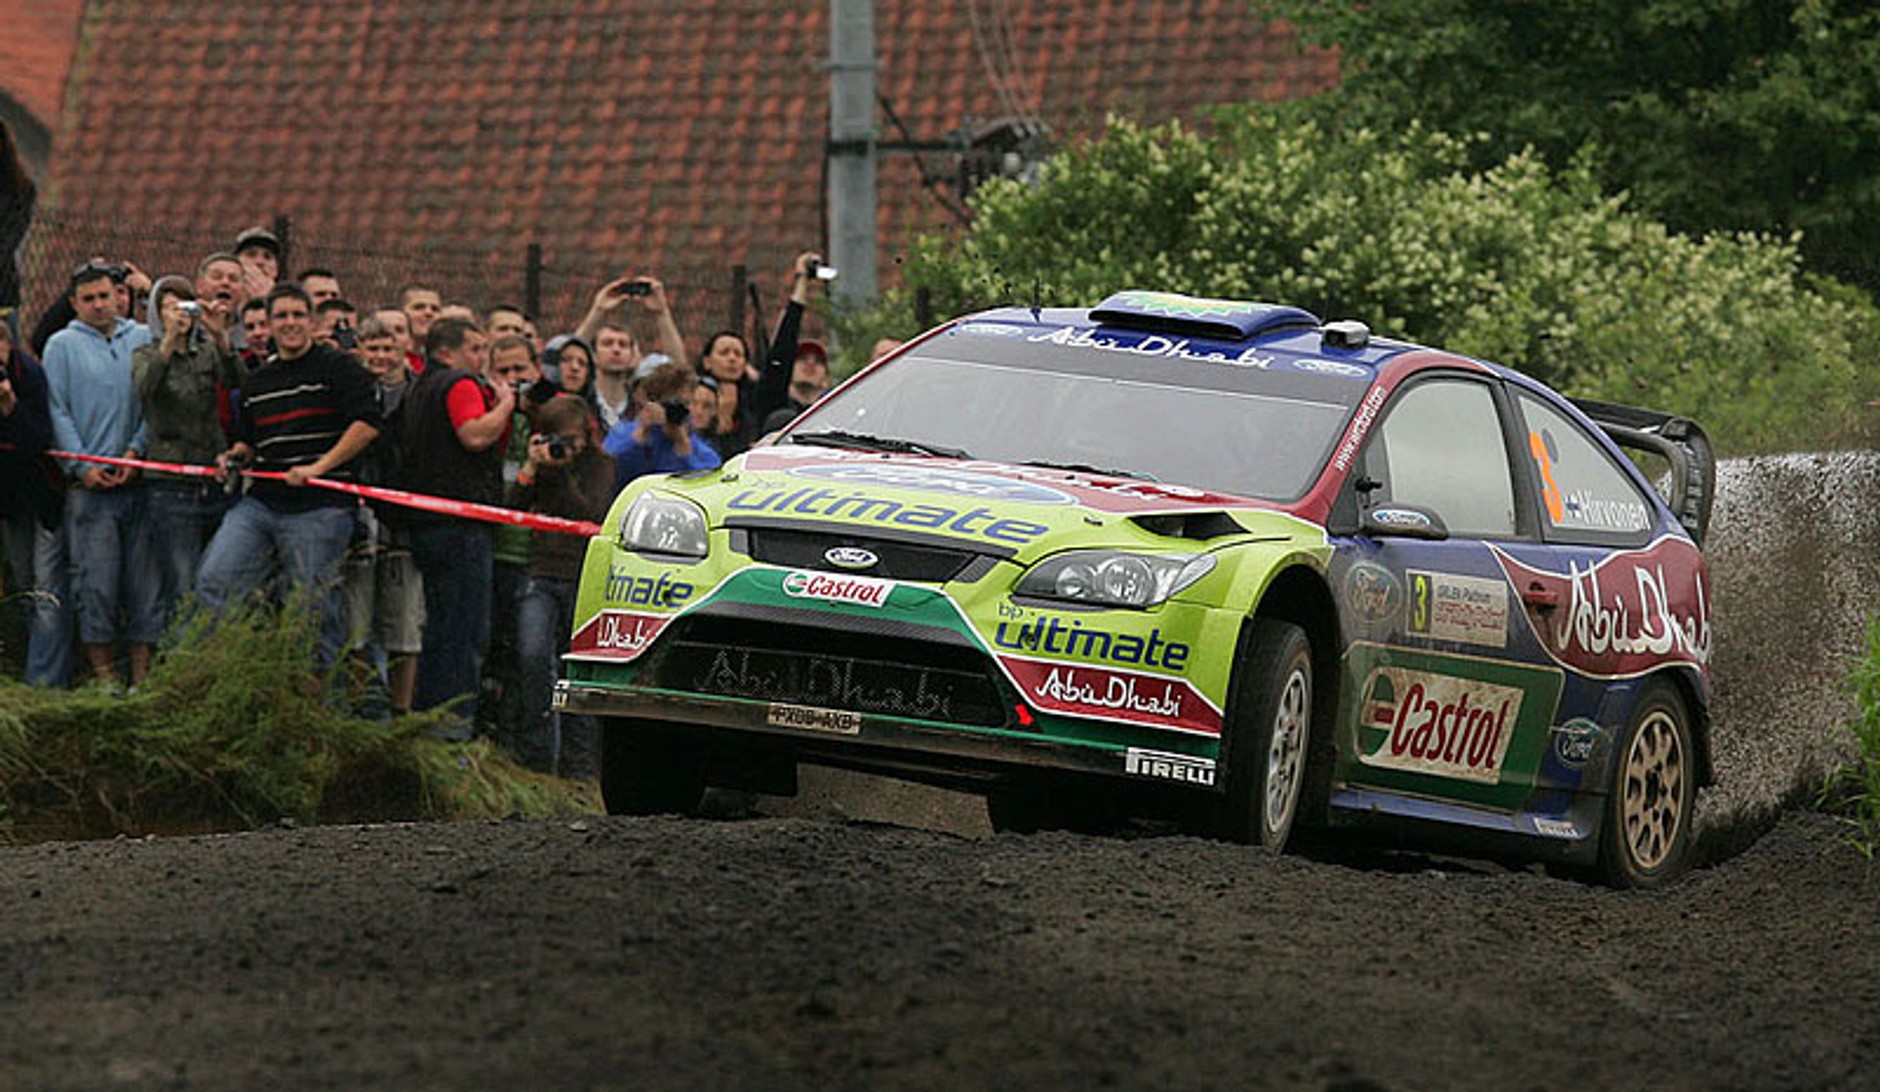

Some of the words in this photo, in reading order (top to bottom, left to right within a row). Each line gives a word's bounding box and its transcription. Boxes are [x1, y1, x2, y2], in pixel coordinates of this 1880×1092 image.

[1529, 431, 1562, 523] 3
[727, 487, 1049, 544] ultimate
[807, 575, 885, 604] Castrol
[999, 604, 1024, 620] bp
[1414, 574, 1427, 631] 3
[995, 617, 1190, 671] ultimate
[1391, 683, 1510, 769] Castrol
[1126, 747, 1216, 786] PIRELLI
